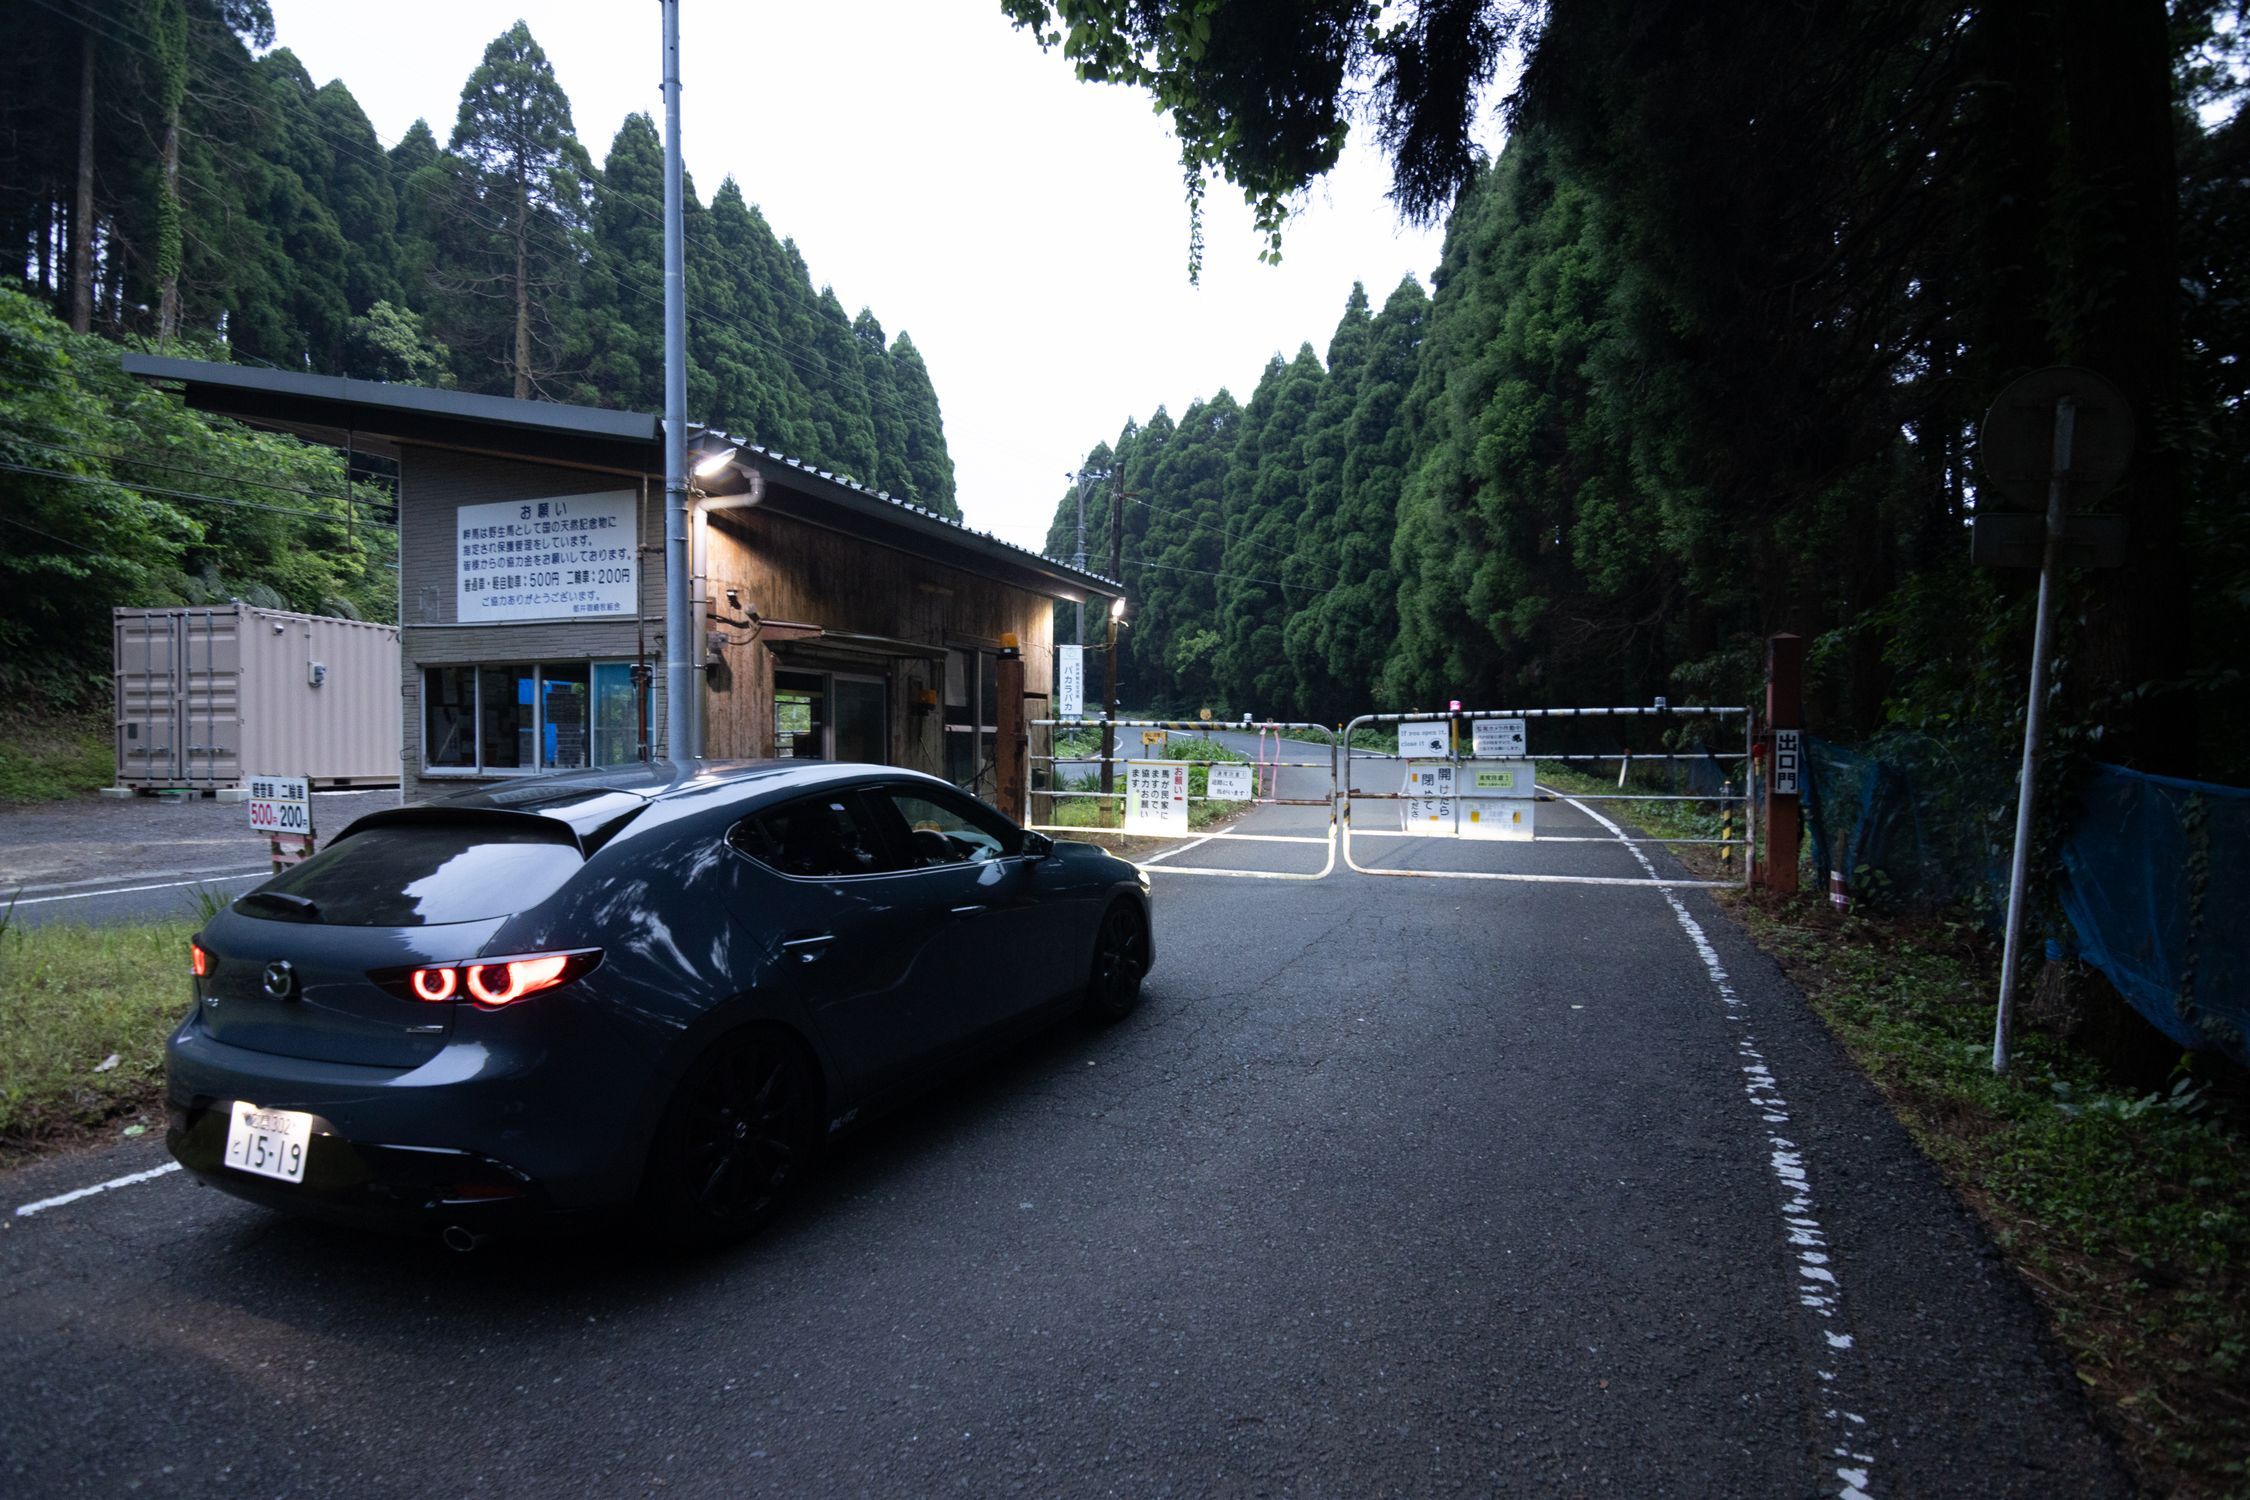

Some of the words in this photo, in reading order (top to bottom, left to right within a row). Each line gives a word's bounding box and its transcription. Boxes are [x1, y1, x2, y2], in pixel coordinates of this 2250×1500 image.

[520, 502, 567, 520] お願い
[482, 590, 600, 607] ご協力ありがとうございます。
[1778, 733, 1797, 790] 出口門
[1174, 767, 1183, 794] お願い
[1161, 769, 1169, 820] 馬が民家に
